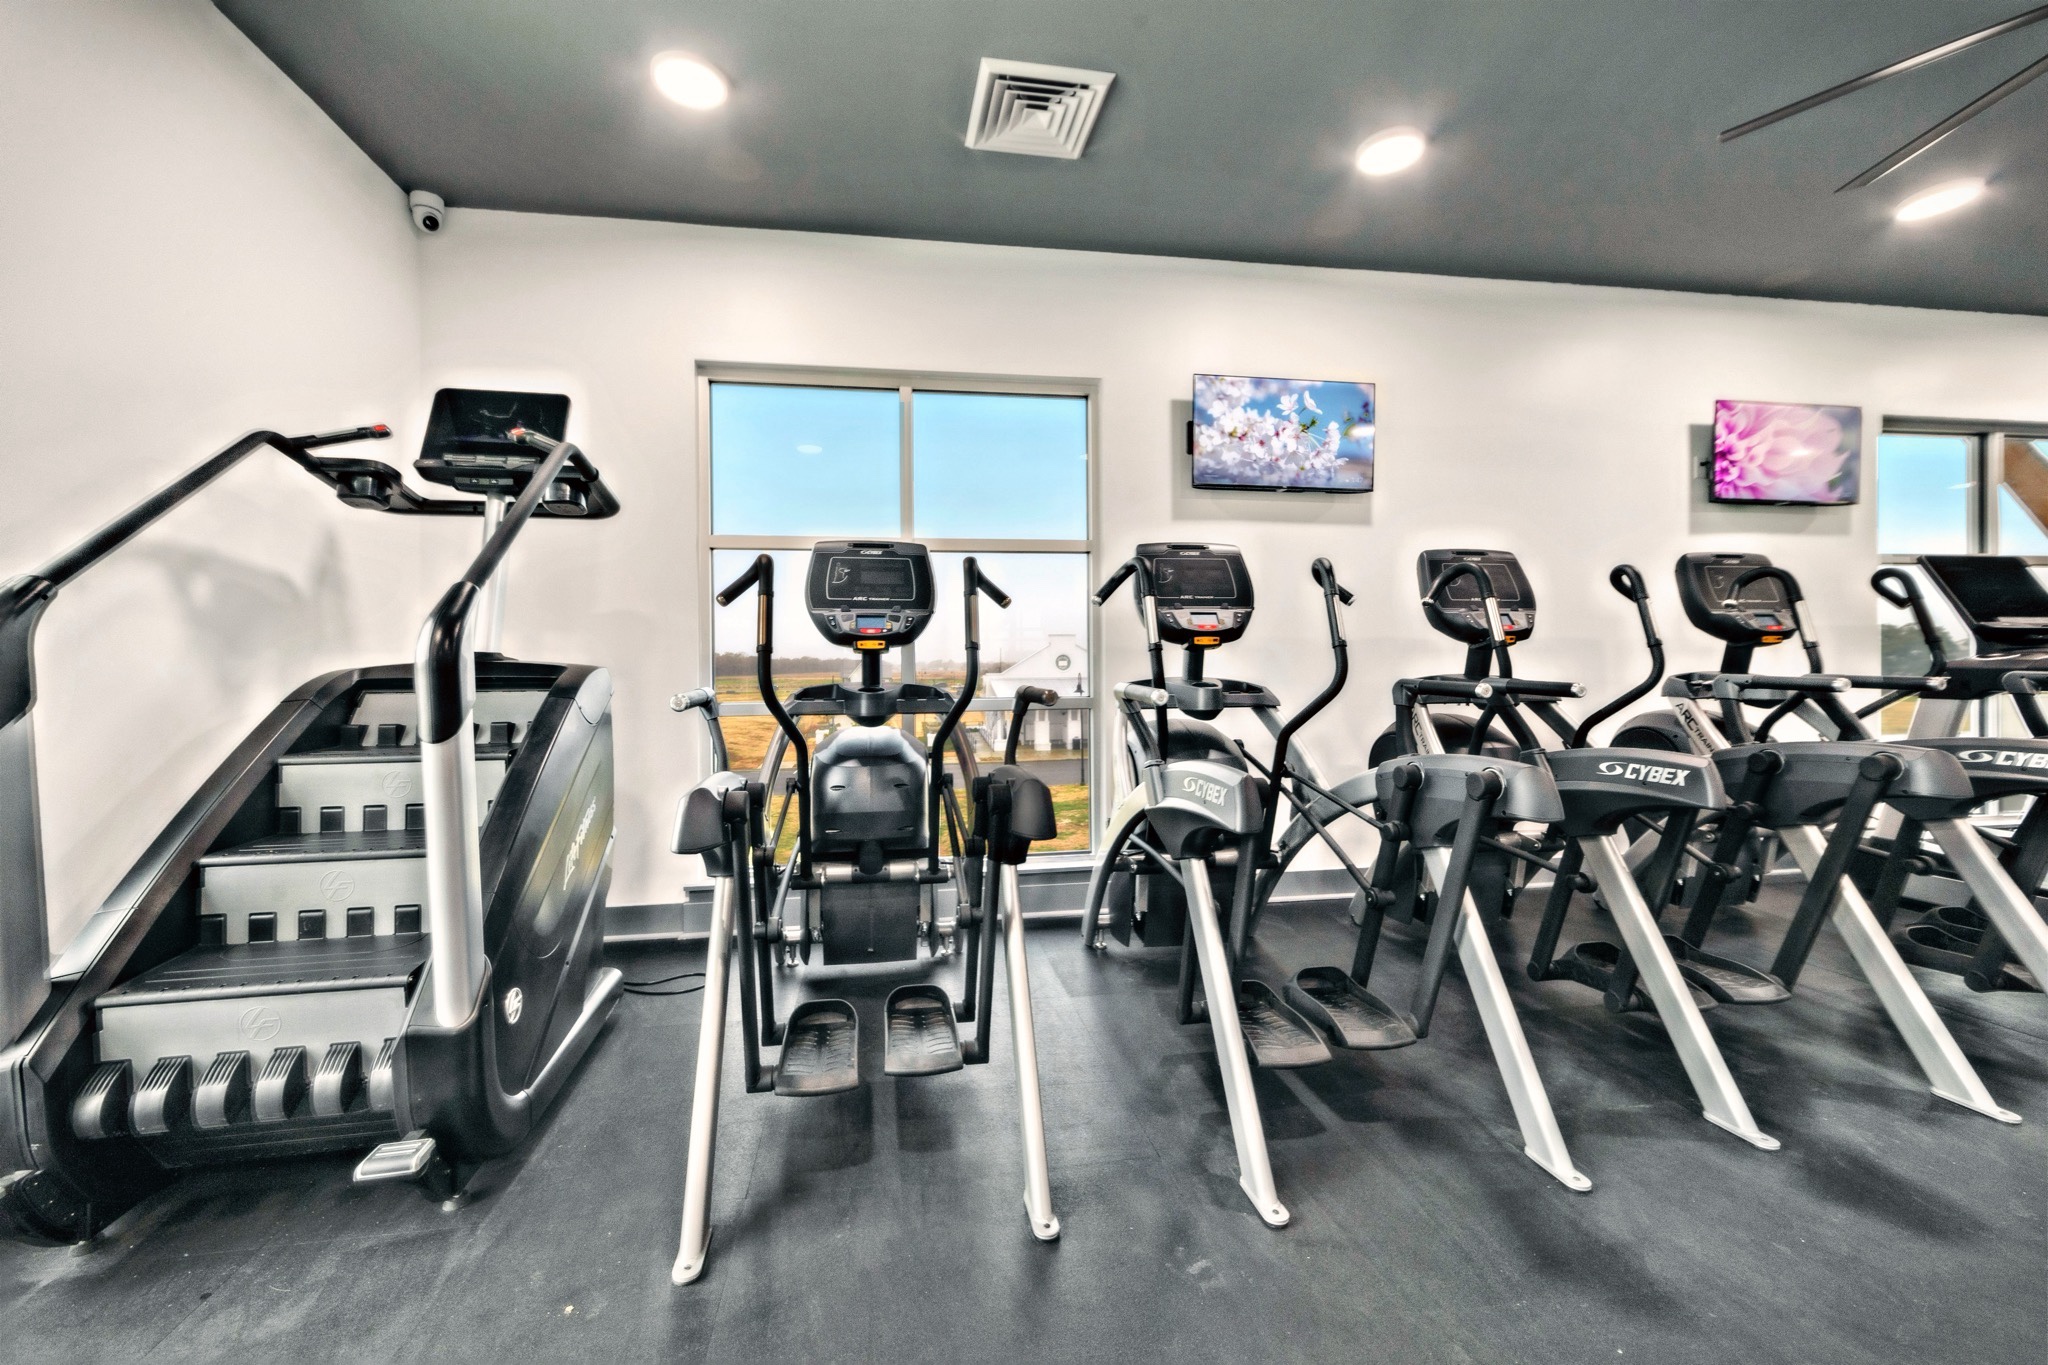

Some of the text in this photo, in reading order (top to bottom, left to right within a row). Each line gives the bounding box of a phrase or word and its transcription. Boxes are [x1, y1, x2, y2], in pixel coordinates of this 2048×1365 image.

[1993, 750, 2048, 769] CYB
[1623, 763, 1692, 787] CYBEX
[1194, 779, 1228, 807] CYBEX
